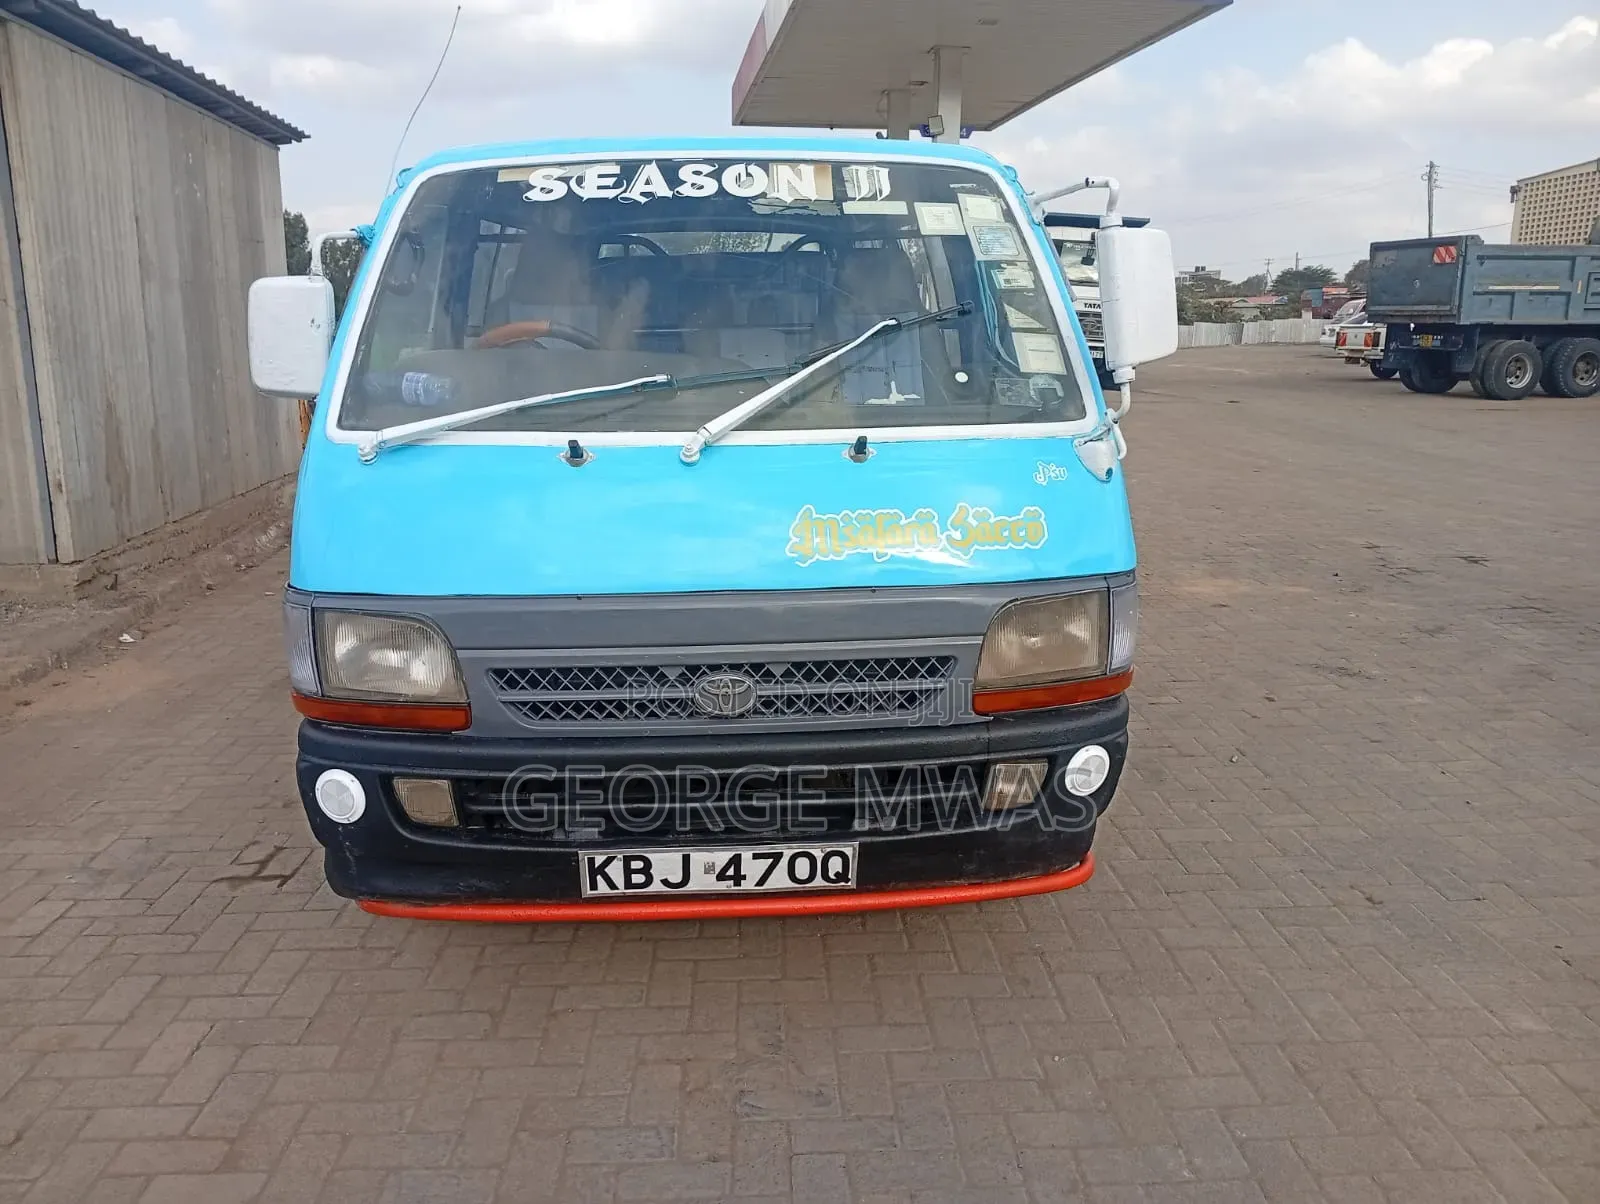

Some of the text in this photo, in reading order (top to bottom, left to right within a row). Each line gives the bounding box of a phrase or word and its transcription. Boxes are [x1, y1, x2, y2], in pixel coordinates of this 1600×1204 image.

[522, 160, 820, 205] SEASON
[587, 850, 851, 891] KBJ 470Q
